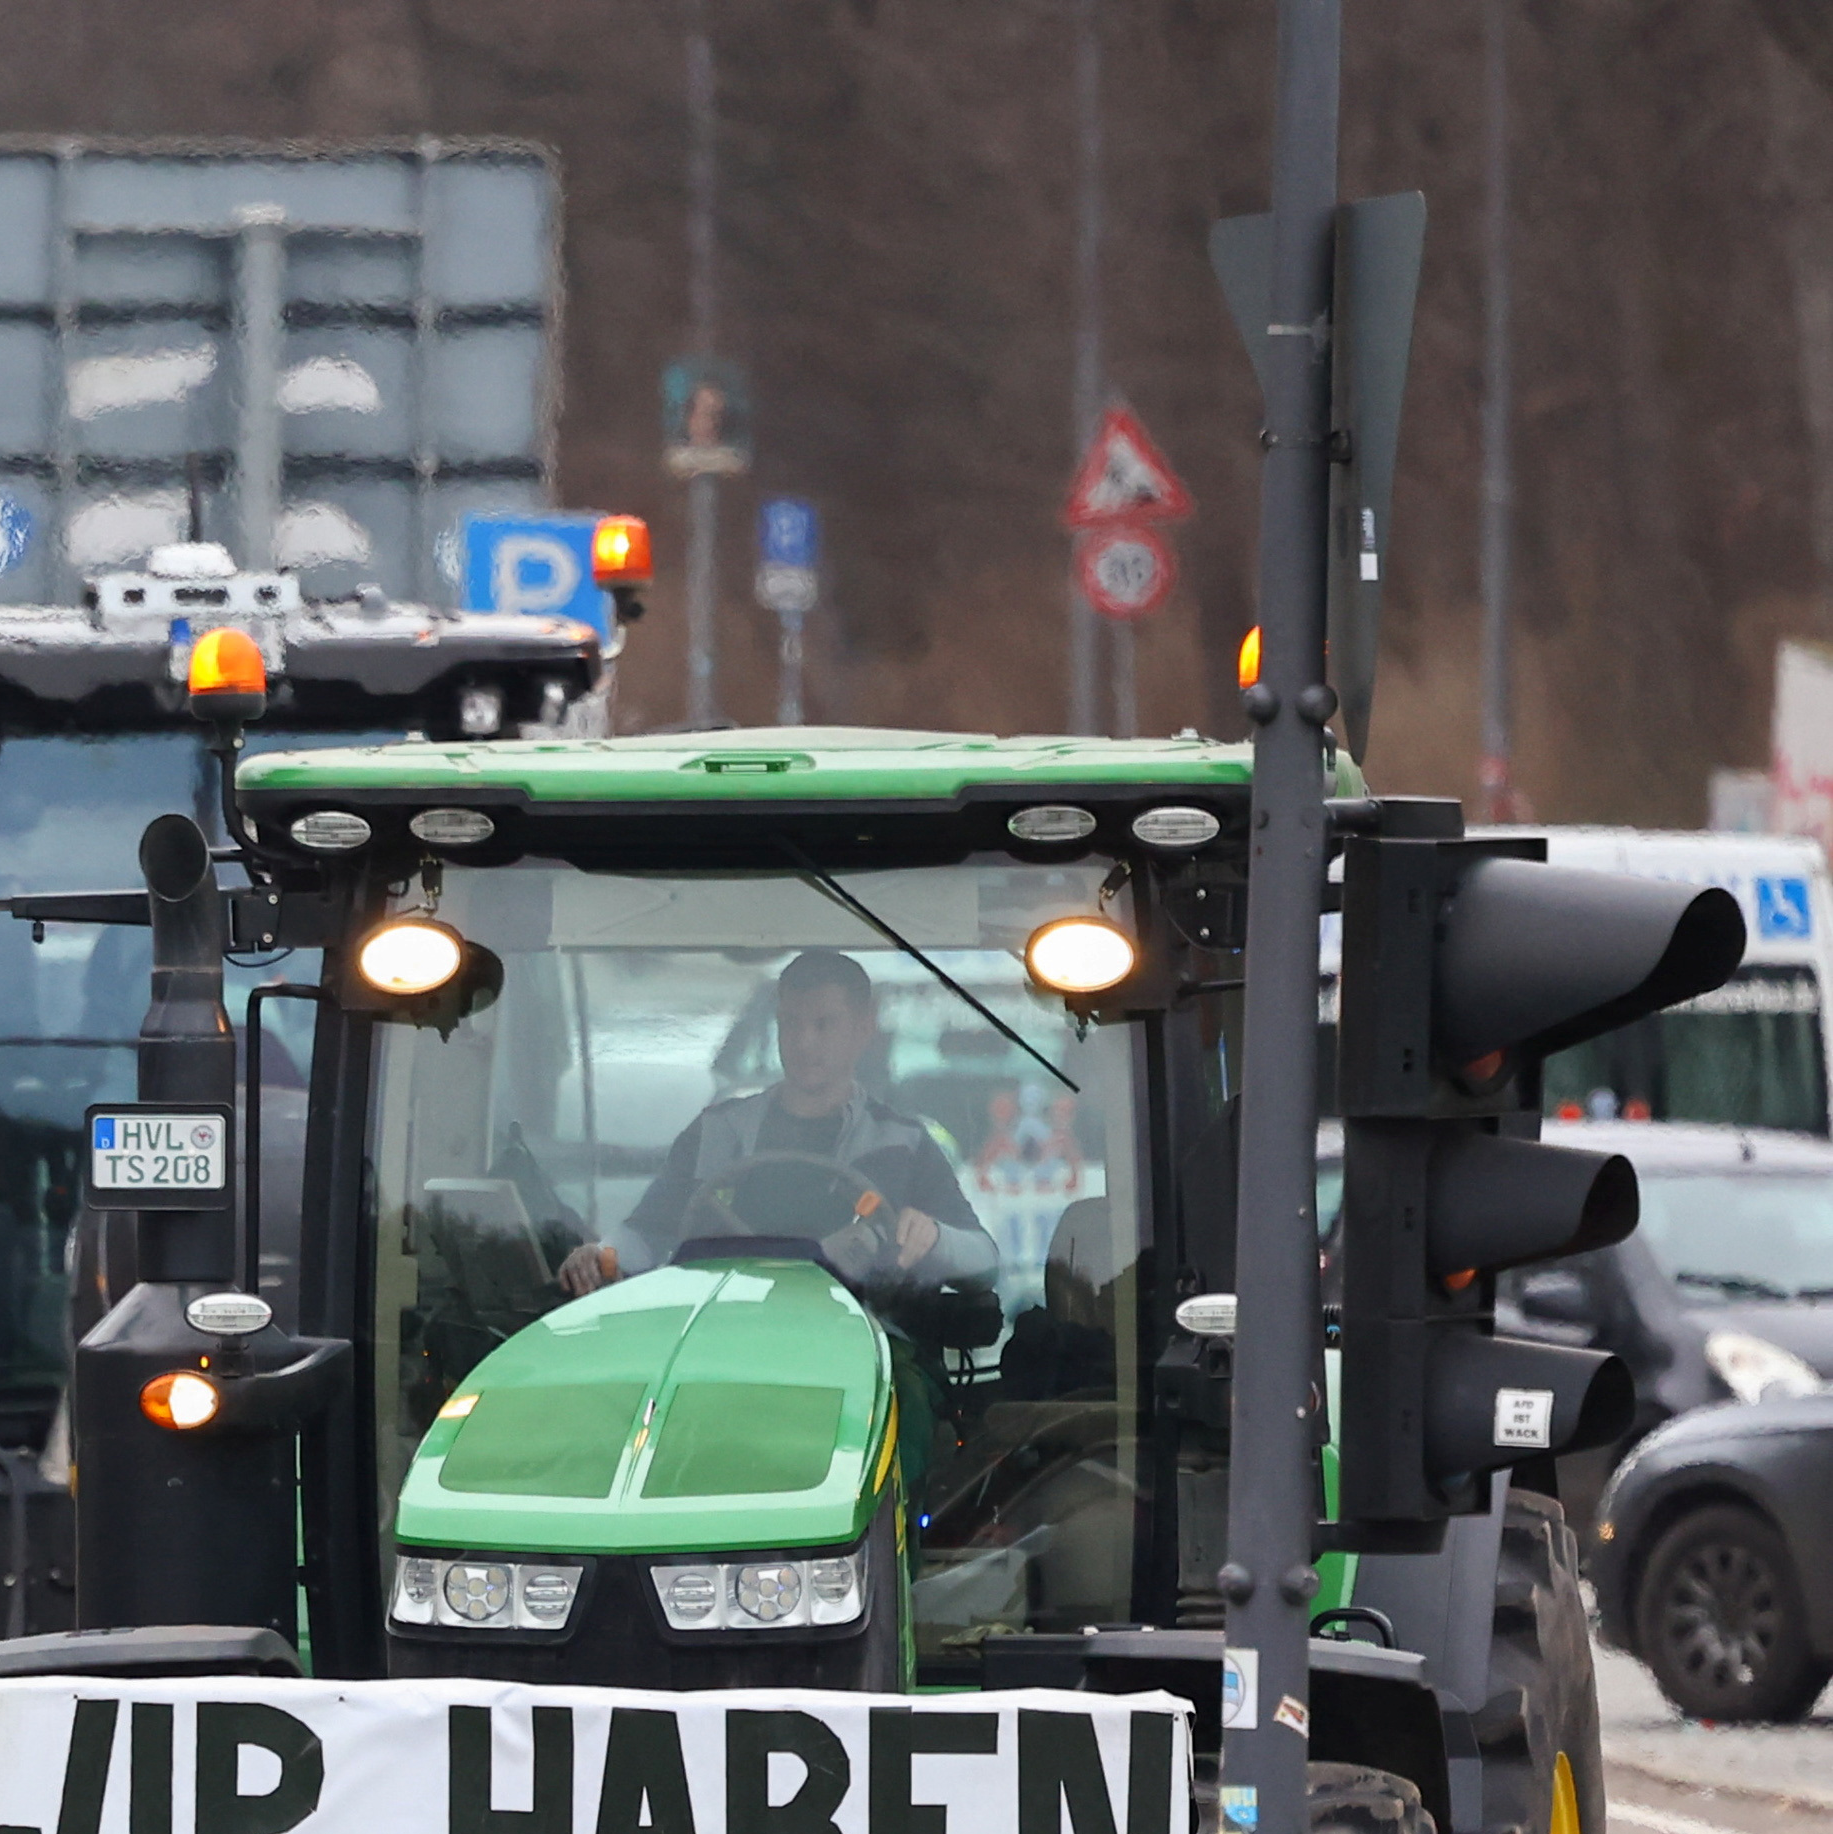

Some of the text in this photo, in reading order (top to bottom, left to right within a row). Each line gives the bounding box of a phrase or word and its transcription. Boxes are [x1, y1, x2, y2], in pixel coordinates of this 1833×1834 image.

[498, 534, 581, 616] P
[122, 1121, 184, 1150] HVL
[105, 1155, 211, 1184] TS 208
